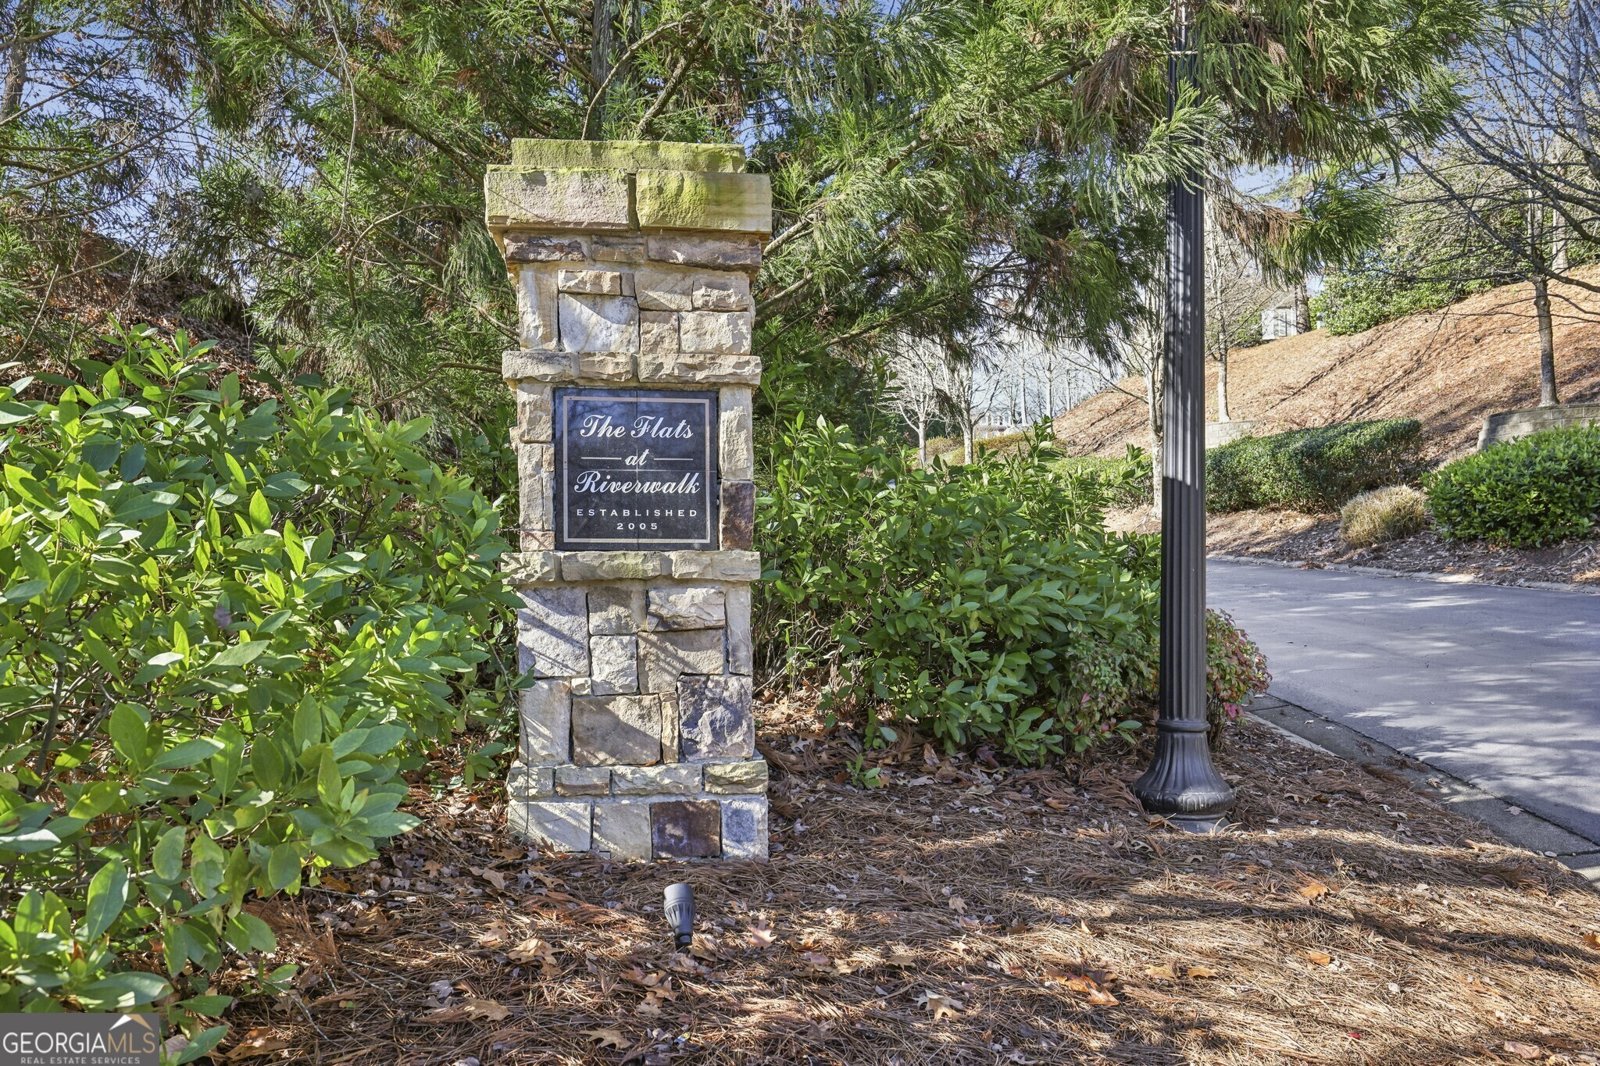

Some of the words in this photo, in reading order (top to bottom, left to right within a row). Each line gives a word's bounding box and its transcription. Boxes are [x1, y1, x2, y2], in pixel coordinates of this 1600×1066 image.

[579, 414, 626, 438] The
[630, 415, 694, 439] Flats
[624, 448, 650, 466] at
[573, 470, 701, 494] Riverwalk
[576, 508, 698, 517] ESTABLISHED
[616, 522, 658, 530] 2005
